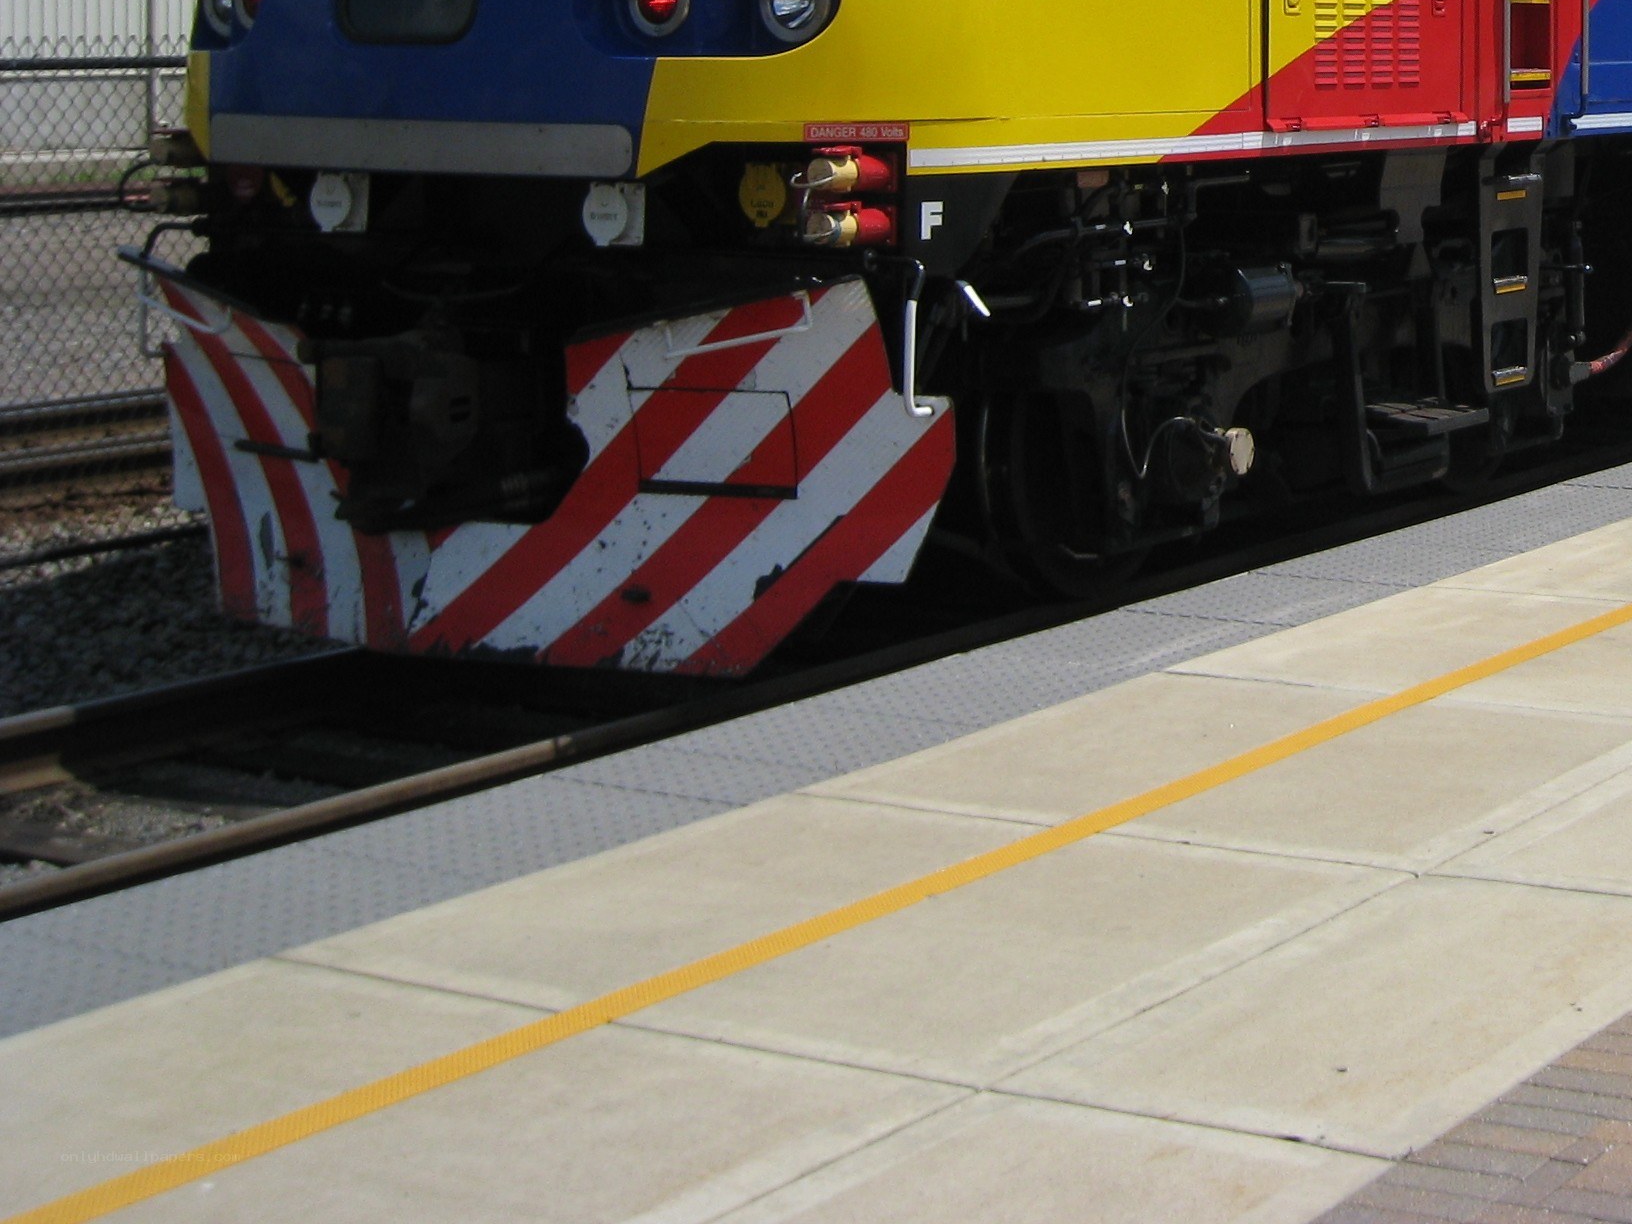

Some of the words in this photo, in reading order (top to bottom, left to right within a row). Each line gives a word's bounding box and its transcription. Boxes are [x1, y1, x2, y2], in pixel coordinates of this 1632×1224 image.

[810, 126, 856, 138] DANGER
[860, 126, 878, 138] 480
[880, 126, 904, 138] Volts
[920, 201, 944, 240] F
